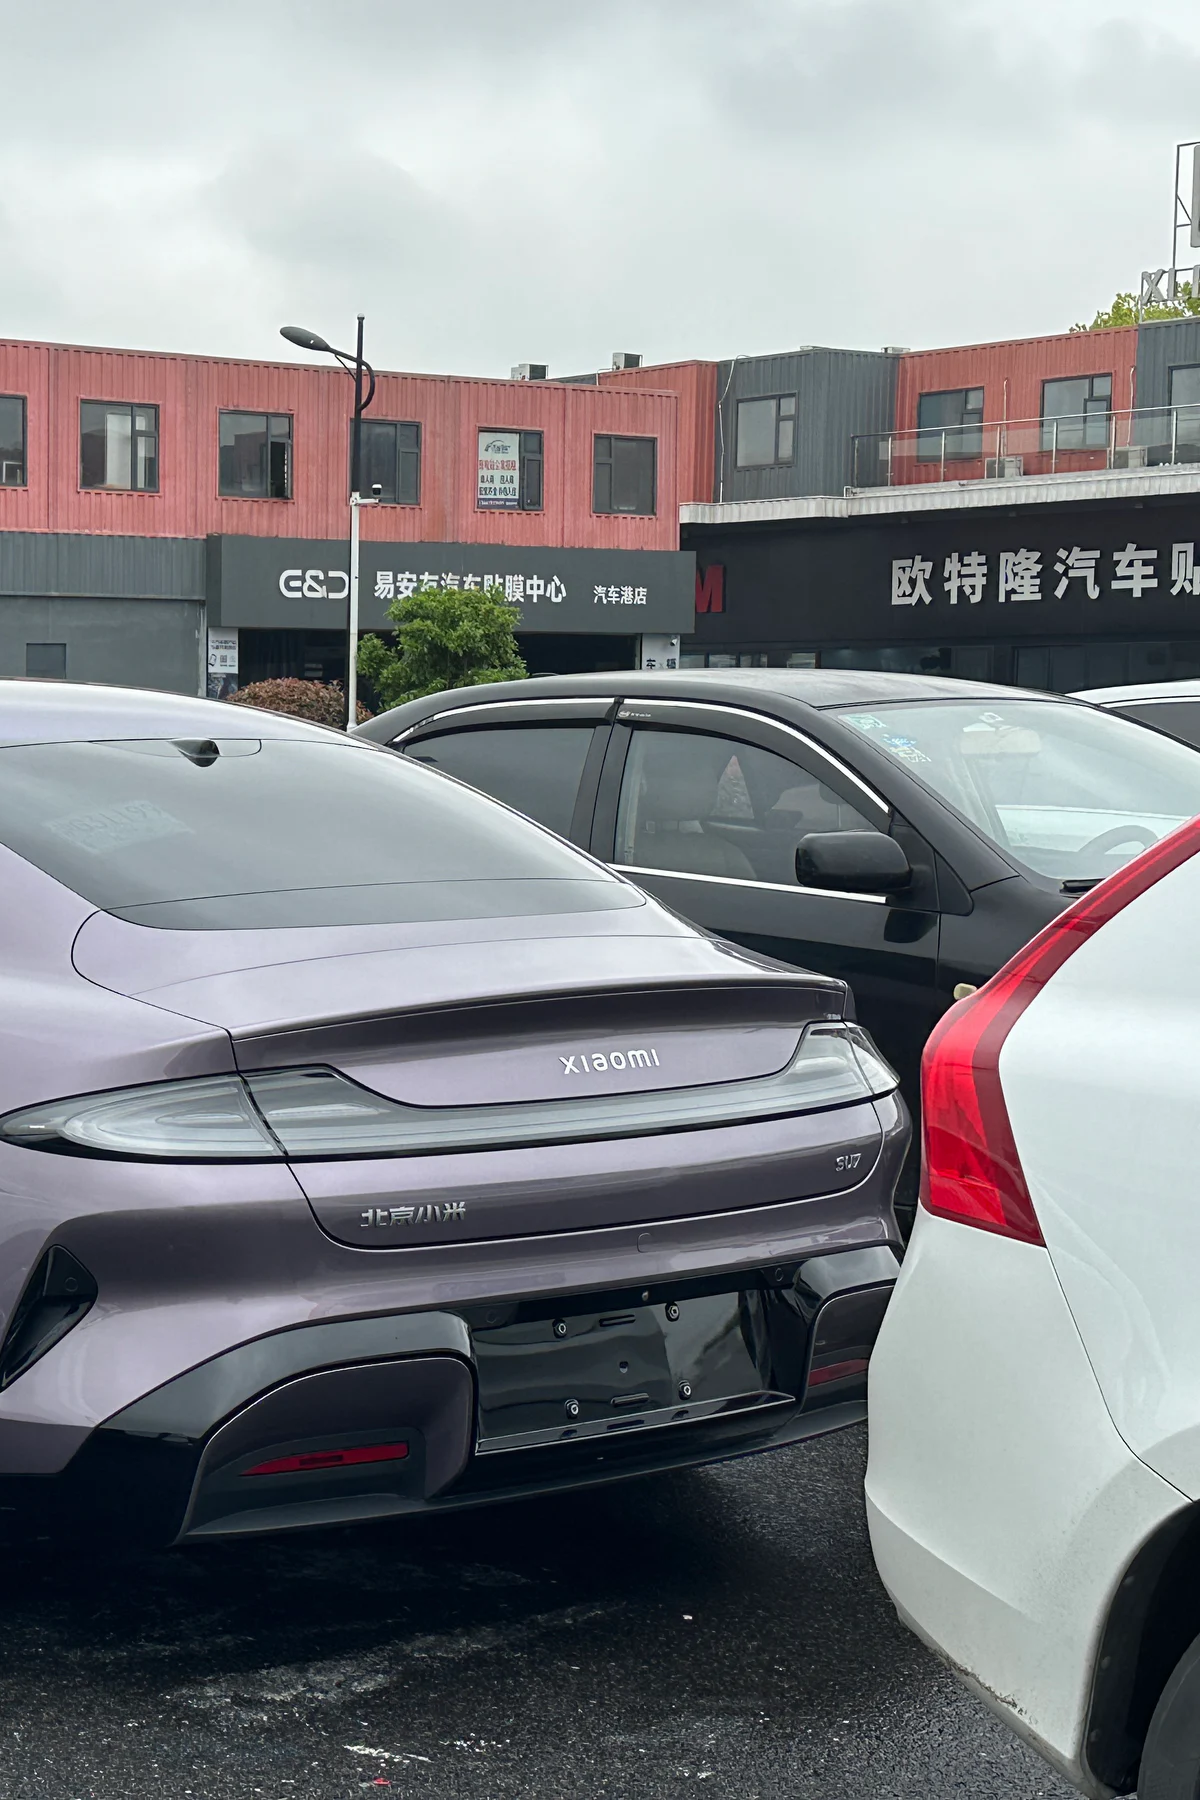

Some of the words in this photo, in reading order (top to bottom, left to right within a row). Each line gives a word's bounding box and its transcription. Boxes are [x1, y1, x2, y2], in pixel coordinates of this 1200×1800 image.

[593, 585, 647, 604] 汽车港店
[559, 1048, 660, 1075] xiaomi
[835, 1153, 862, 1172] SU7
[360, 1201, 466, 1227] 北京小米
